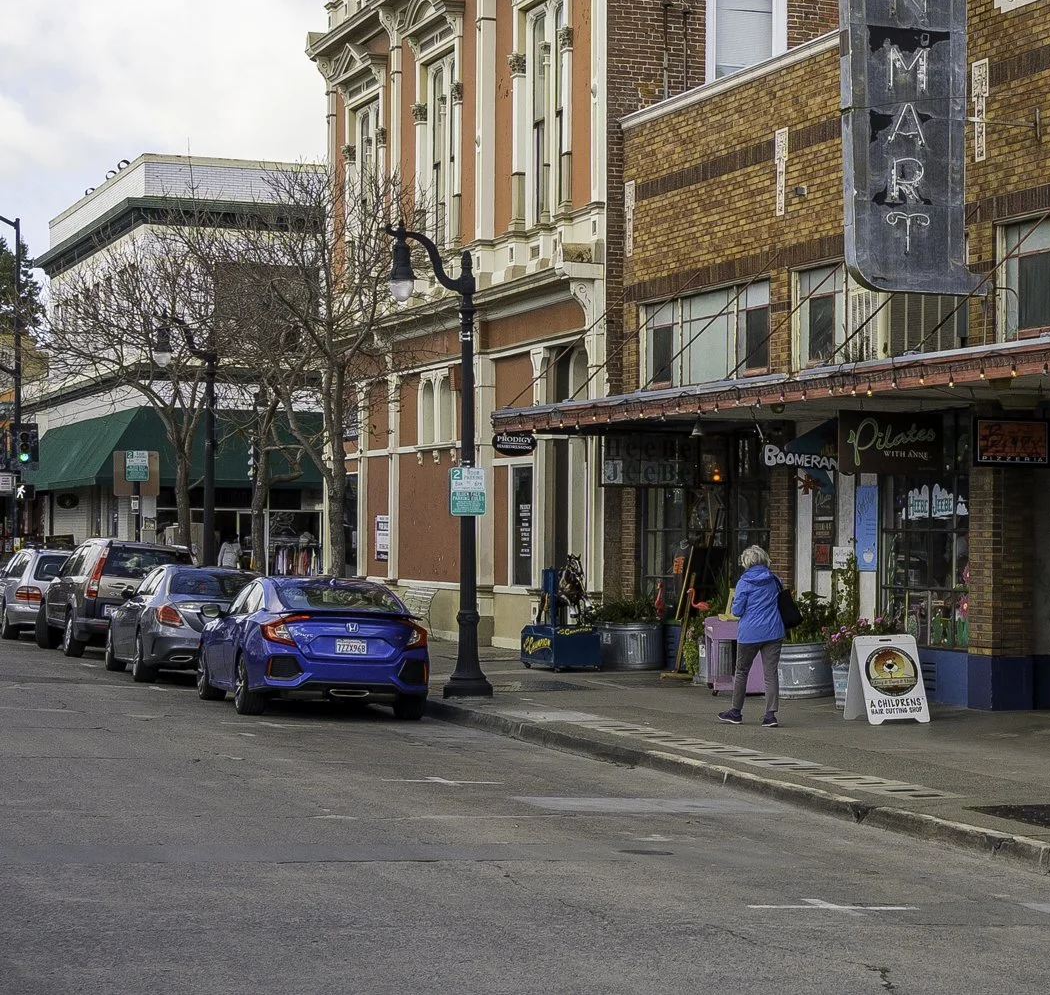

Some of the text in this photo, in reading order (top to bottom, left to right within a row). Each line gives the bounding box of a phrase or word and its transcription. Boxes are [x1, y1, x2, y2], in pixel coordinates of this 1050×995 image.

[497, 435, 532, 443] PRODIGY
[847, 417, 937, 466] Pilates
[764, 444, 838, 470] BOOMERAN
[884, 449, 929, 460] WITH ANNE
[453, 469, 461, 479] 2
[870, 699, 876, 708] A
[885, 707, 908, 715] CUTTING
[908, 706, 923, 714] SHOP
